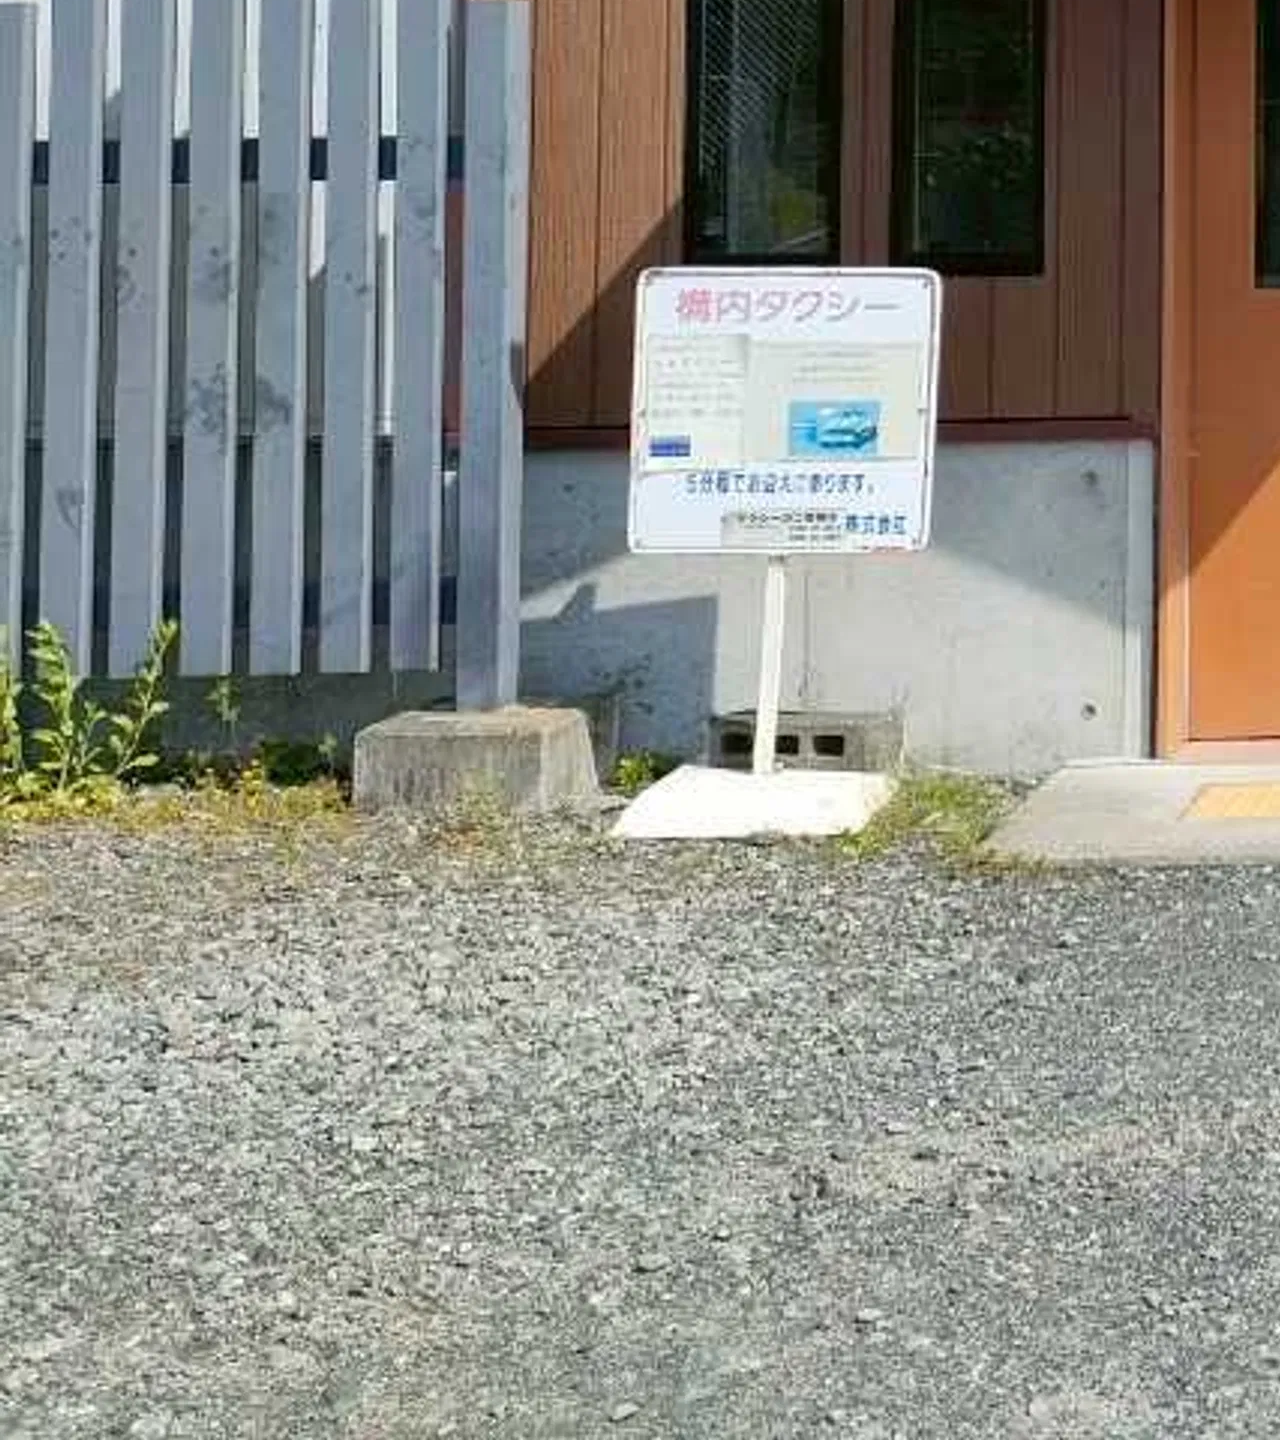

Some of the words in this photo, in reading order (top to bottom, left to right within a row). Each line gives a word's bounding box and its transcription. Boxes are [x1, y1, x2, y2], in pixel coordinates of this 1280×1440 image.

[677, 289, 899, 322] 構内タクシー
